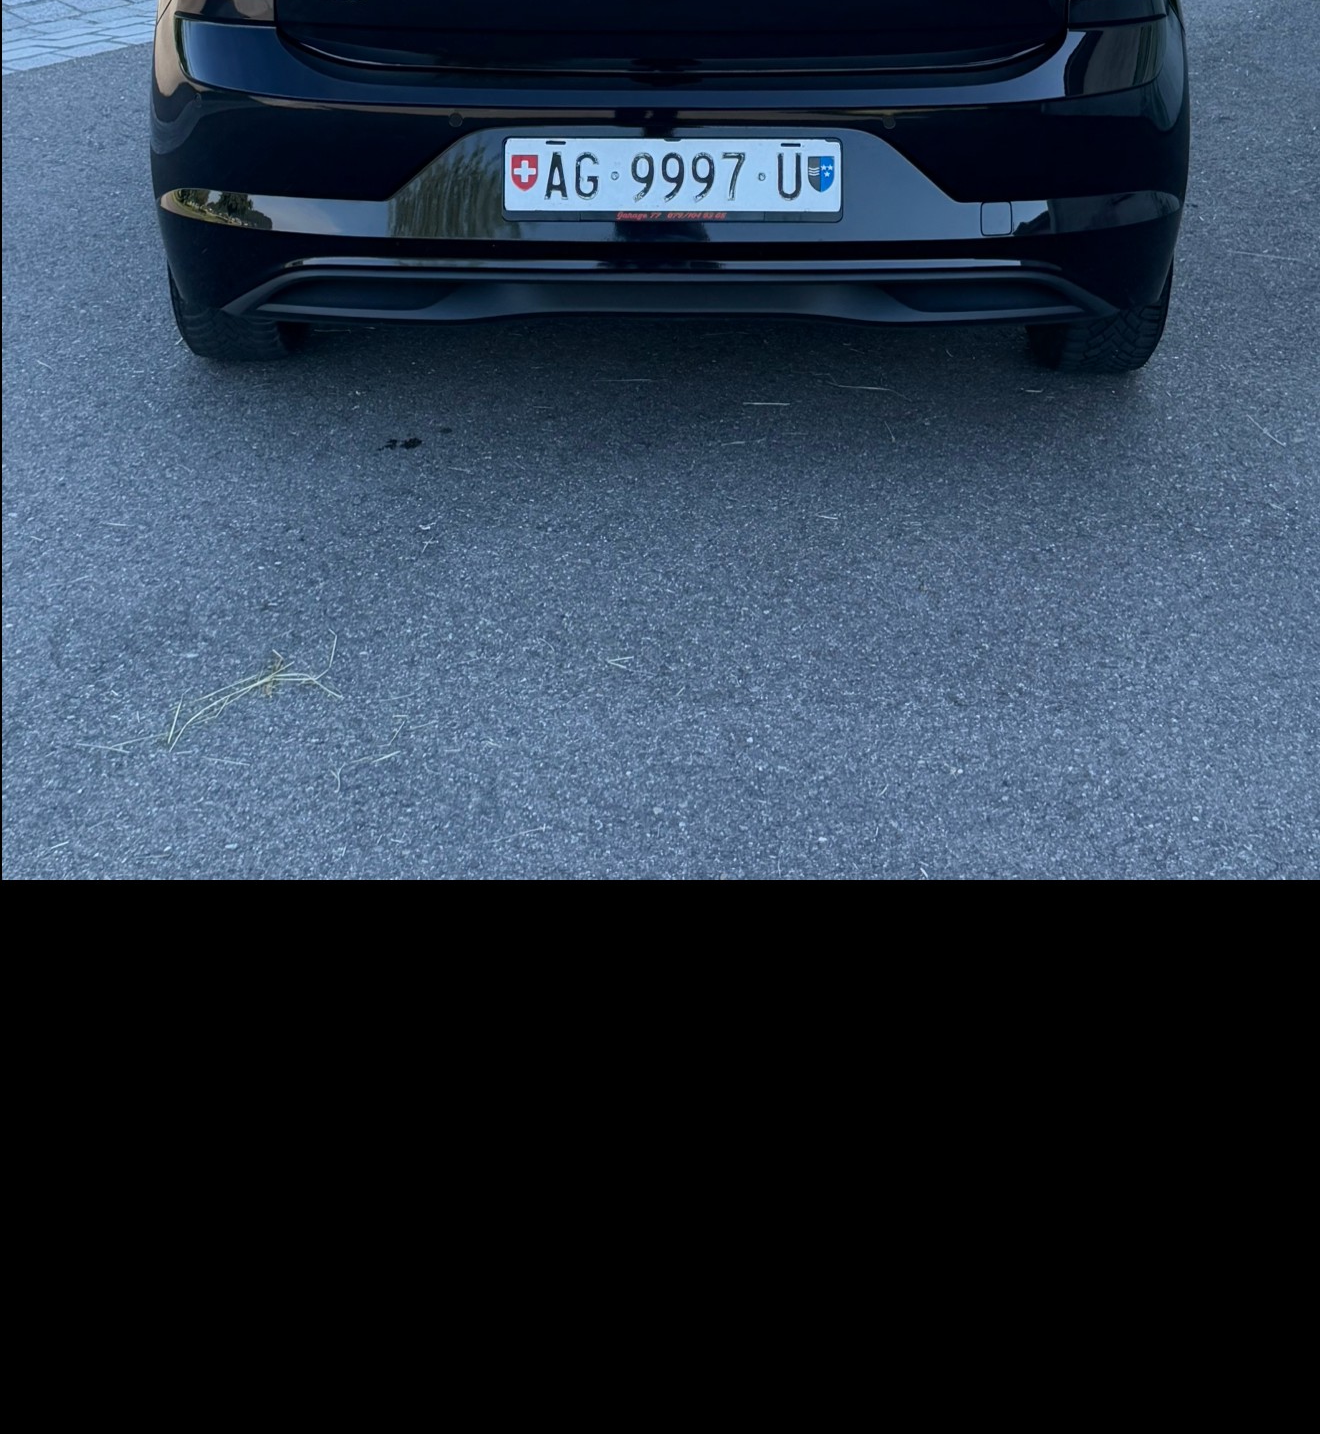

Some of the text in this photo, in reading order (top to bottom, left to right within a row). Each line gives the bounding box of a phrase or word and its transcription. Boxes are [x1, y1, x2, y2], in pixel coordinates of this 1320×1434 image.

[544, 151, 802, 203] AG 9997 U
